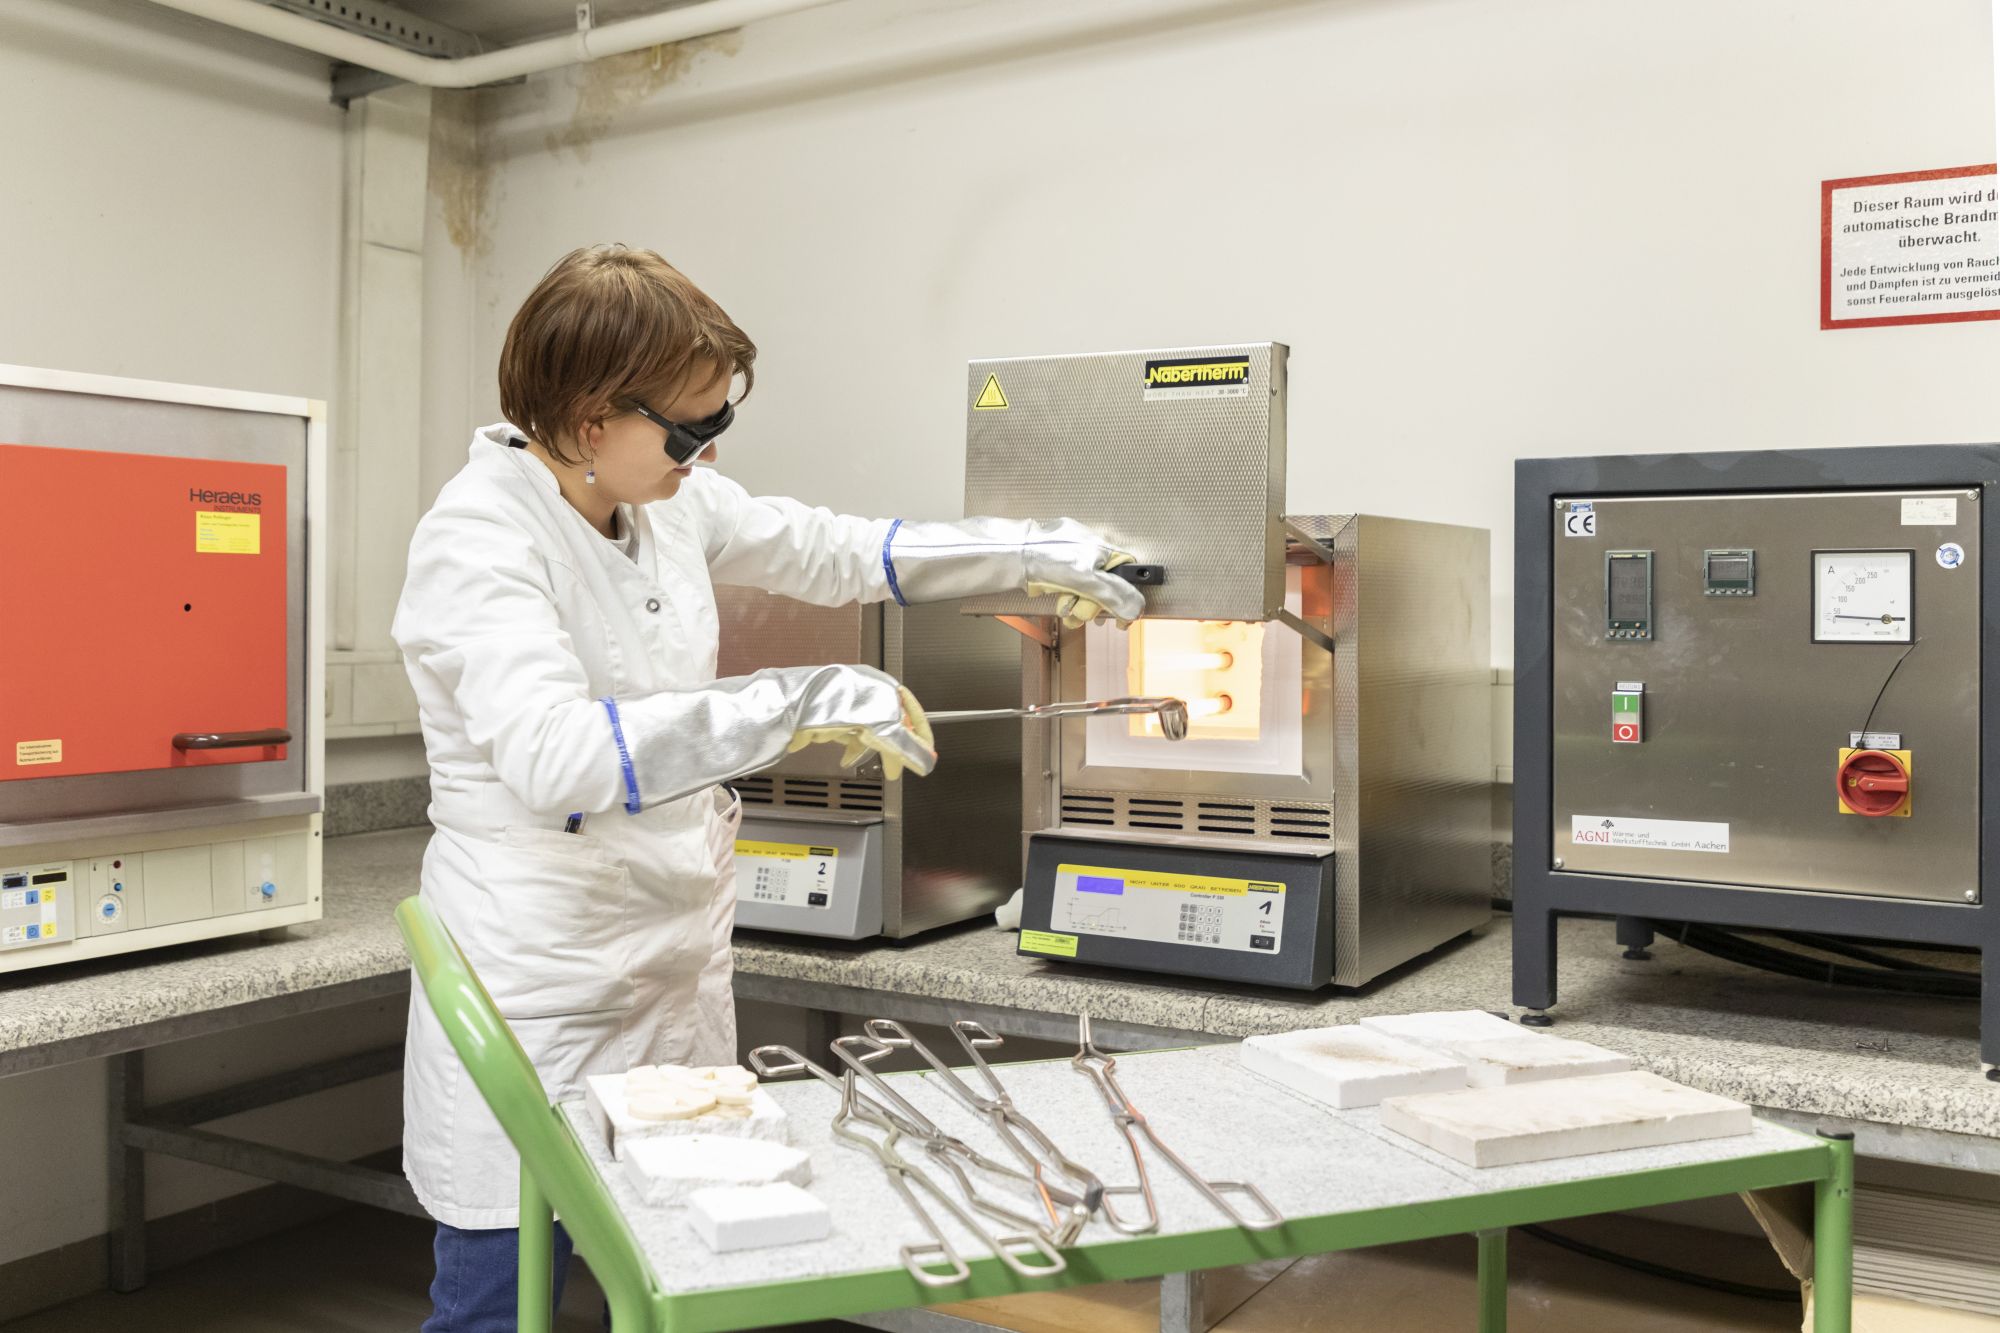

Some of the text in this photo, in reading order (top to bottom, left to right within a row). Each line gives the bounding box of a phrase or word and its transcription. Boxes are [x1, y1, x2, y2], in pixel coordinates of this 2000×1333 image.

[1853, 200, 1900, 214] Dieser
[1903, 196, 1944, 209] Raum
[1948, 190, 1982, 205] wird
[1843, 215, 1940, 233] automatische
[1898, 231, 1981, 248] überwacht.
[1840, 266, 1867, 278] Jede
[1870, 262, 1940, 276] Entwicklung
[1943, 260, 1963, 270] von
[1846, 281, 1866, 291] und
[1922, 275, 1936, 286] ist
[1938, 276, 1951, 285] zu
[1847, 297, 1876, 307] sonst
[1879, 292, 1943, 305] Feueralarm
[1145, 362, 1249, 383] Nabertherm
[190, 488, 262, 506] Heraeus
[1828, 565, 1835, 574] A
[1838, 595, 1848, 603] 100
[1575, 830, 1609, 843] AGNI
[1694, 841, 1727, 850] Aachen
[818, 862, 826, 875] 2
